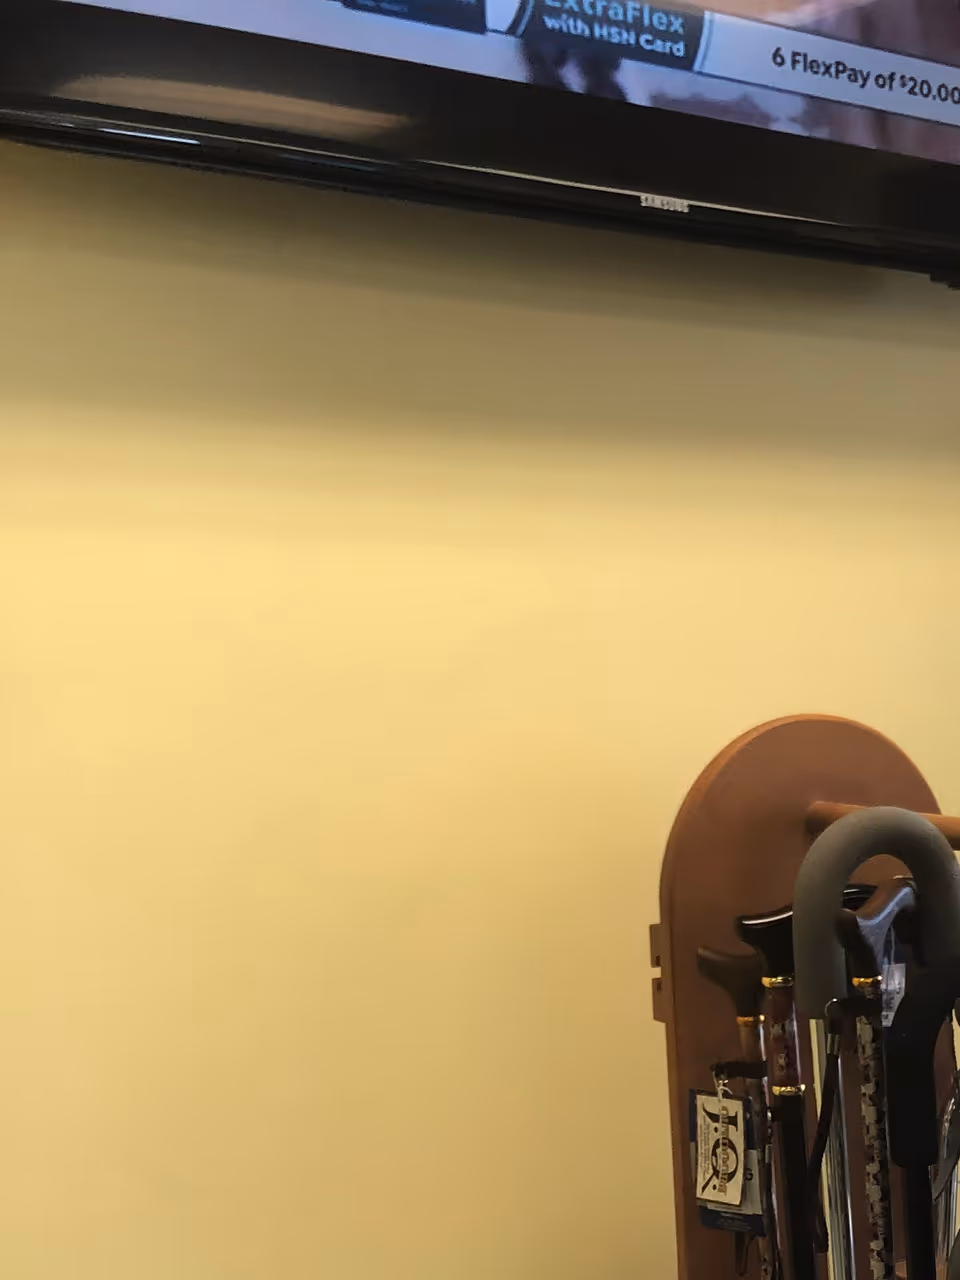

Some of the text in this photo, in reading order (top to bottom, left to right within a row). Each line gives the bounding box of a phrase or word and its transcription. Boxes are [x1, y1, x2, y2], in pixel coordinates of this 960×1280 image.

[543, 13, 686, 58] with HSN Card
[771, 46, 786, 68] 6
[790, 50, 871, 89] FlexPay
[874, 71, 896, 92] of
